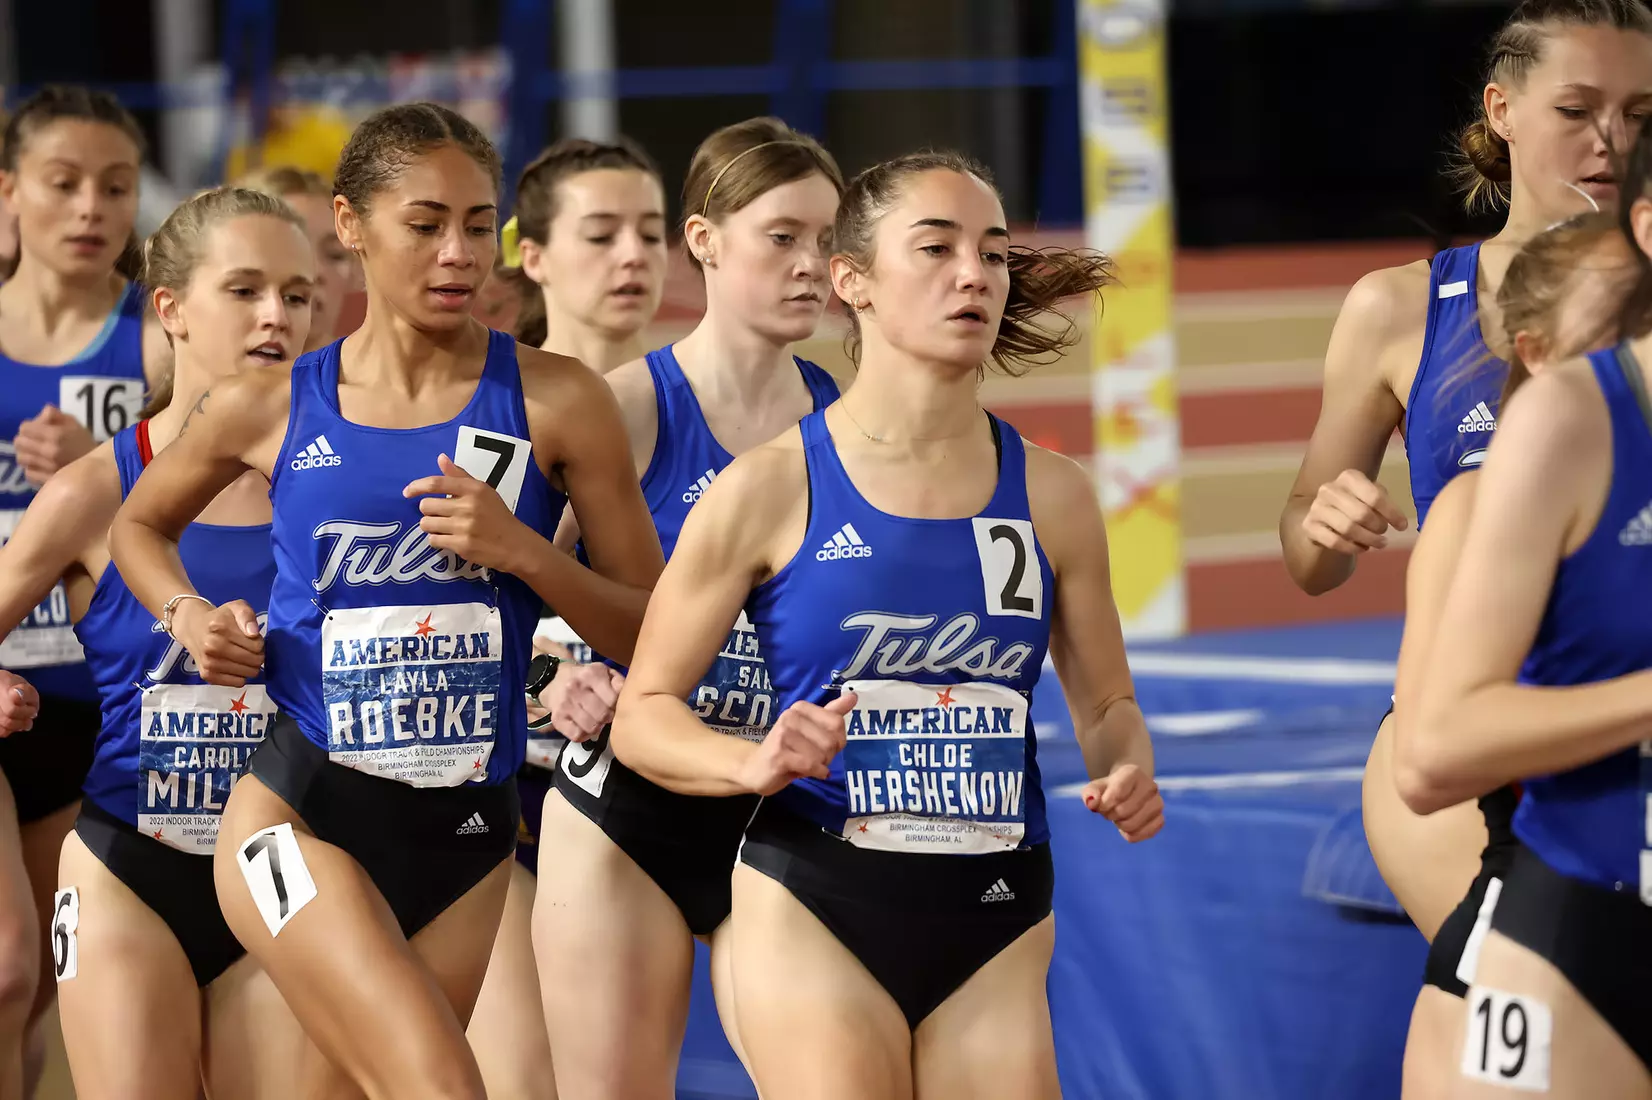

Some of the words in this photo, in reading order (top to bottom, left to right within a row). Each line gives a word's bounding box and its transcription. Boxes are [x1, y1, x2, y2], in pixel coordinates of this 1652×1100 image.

[76, 382, 127, 441] 16
[291, 454, 341, 471] adidas
[473, 434, 516, 491] 7
[815, 543, 872, 561] adidas
[989, 524, 1034, 613] 2
[329, 631, 490, 667] AMERICAN
[831, 610, 1035, 681] Tulsa
[379, 669, 448, 694] LAYLA
[328, 693, 495, 745] ROEBKE
[693, 685, 778, 729] SCO
[847, 706, 1014, 735] AMERICAN
[341, 754, 358, 763] 2022
[414, 749, 420, 757] &
[435, 745, 485, 756] CHAMPIONSHIPS
[378, 759, 423, 770] BIRMINGHAM
[899, 743, 972, 768] CHLOE
[147, 770, 238, 810] MIL
[847, 769, 1024, 817] HERSHENOW
[149, 816, 164, 825] 2022
[165, 816, 192, 826] INDOOR
[193, 817, 216, 826] TRACK
[182, 828, 219, 836] BIRMINGHA
[456, 825, 490, 835] adidas
[889, 823, 936, 832] BIRMINGHAM
[936, 824, 977, 833] CROSSPLEX
[953, 835, 963, 843] AL
[244, 831, 289, 920] 7
[981, 891, 1015, 903] adidas
[55, 891, 72, 977] 6
[1476, 996, 1529, 1078] 19
